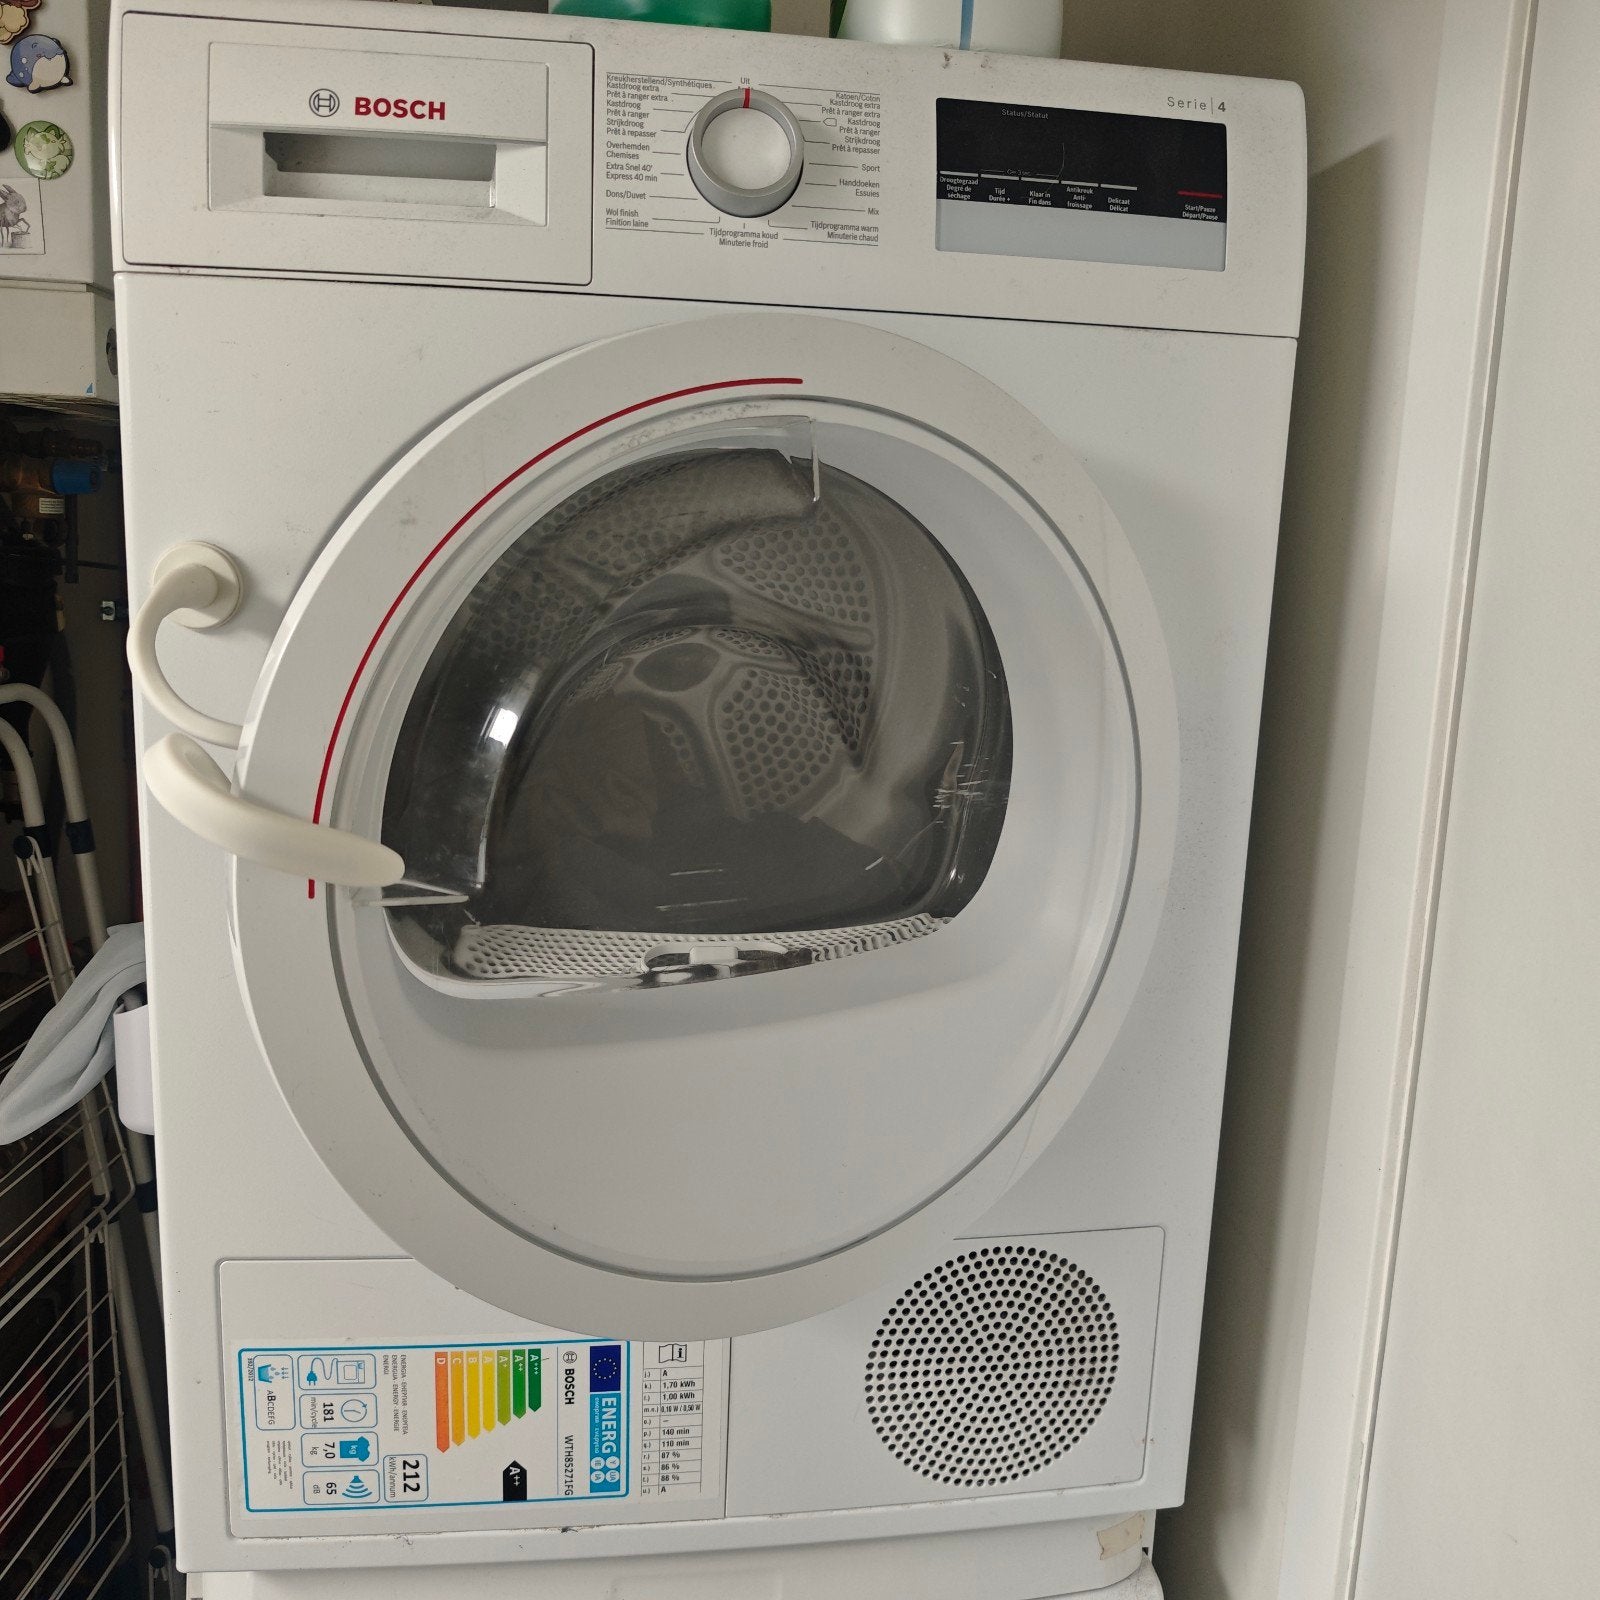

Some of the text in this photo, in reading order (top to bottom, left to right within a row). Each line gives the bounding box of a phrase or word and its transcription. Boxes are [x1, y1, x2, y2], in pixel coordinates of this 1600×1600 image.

[606, 74, 712, 89] Kreukherstellend/Synthétiques
[740, 77, 750, 85] Uit
[606, 82, 659, 92] Kastdroog extra
[606, 90, 621, 98] Prêt
[628, 92, 649, 101] ranger
[836, 92, 880, 102] Katoen/Coton
[355, 97, 445, 120] BOSCH
[606, 99, 641, 110] Kastdroog
[830, 98, 863, 109] Kastdroog
[1167, 96, 1226, 112] Serie 4
[606, 109, 621, 117] Prêt
[628, 112, 650, 121] ranger
[1001, 108, 1048, 119] Status/Statut
[606, 118, 644, 129] Strijkdroog
[847, 118, 880, 129] Kastdroog
[606, 127, 621, 135] Prêt
[628, 130, 657, 138] repasser
[860, 129, 880, 137] ranger
[606, 140, 650, 151] Overhemden
[845, 135, 880, 146] Strijkdroog
[606, 150, 639, 160] Chemises
[853, 147, 880, 155] repasser
[606, 162, 624, 170] Extra
[625, 163, 640, 171] Snel
[862, 164, 880, 172] Sport
[606, 171, 657, 182] Express 40 min
[839, 179, 880, 188] Handdoeken
[606, 189, 646, 200] Dons/Duvet
[855, 189, 879, 197] Essuies
[1066, 186, 1093, 195] Antikreuk
[1067, 201, 1093, 209] froissage
[1108, 197, 1130, 205] Delicaat
[605, 208, 639, 217] Wol finish
[1109, 204, 1128, 212] Délicat
[1184, 204, 1216, 213] Start/Pauze
[1182, 211, 1218, 221] Départ/Pause
[605, 218, 649, 227] Finition laine
[810, 220, 860, 231] Tijdprogramma
[709, 228, 778, 239] Tijdprogramma koud
[827, 231, 878, 242] Minuterie chaud
[719, 238, 768, 248] Minuterie froid
[500, 1355, 508, 1368] A+
[514, 1354, 523, 1372] A++
[530, 1354, 539, 1375] A+++
[564, 1368, 575, 1405] BOSCH
[663, 1381, 677, 1389] 1,70
[680, 1380, 695, 1388] kWh
[266, 1389, 276, 1425] ABCDEFG
[310, 1397, 318, 1428] min/cycle
[323, 1402, 334, 1422] 181
[601, 1397, 616, 1454] ENERG
[310, 1446, 319, 1455] kg
[322, 1442, 335, 1459] 7,0
[349, 1444, 357, 1455] kg
[564, 1435, 574, 1496] WTH85271FG
[389, 1457, 397, 1498] kWh/annum
[402, 1459, 420, 1493] 212
[509, 1466, 521, 1487] A++
[313, 1484, 320, 1494] dB
[326, 1482, 337, 1495] 65
